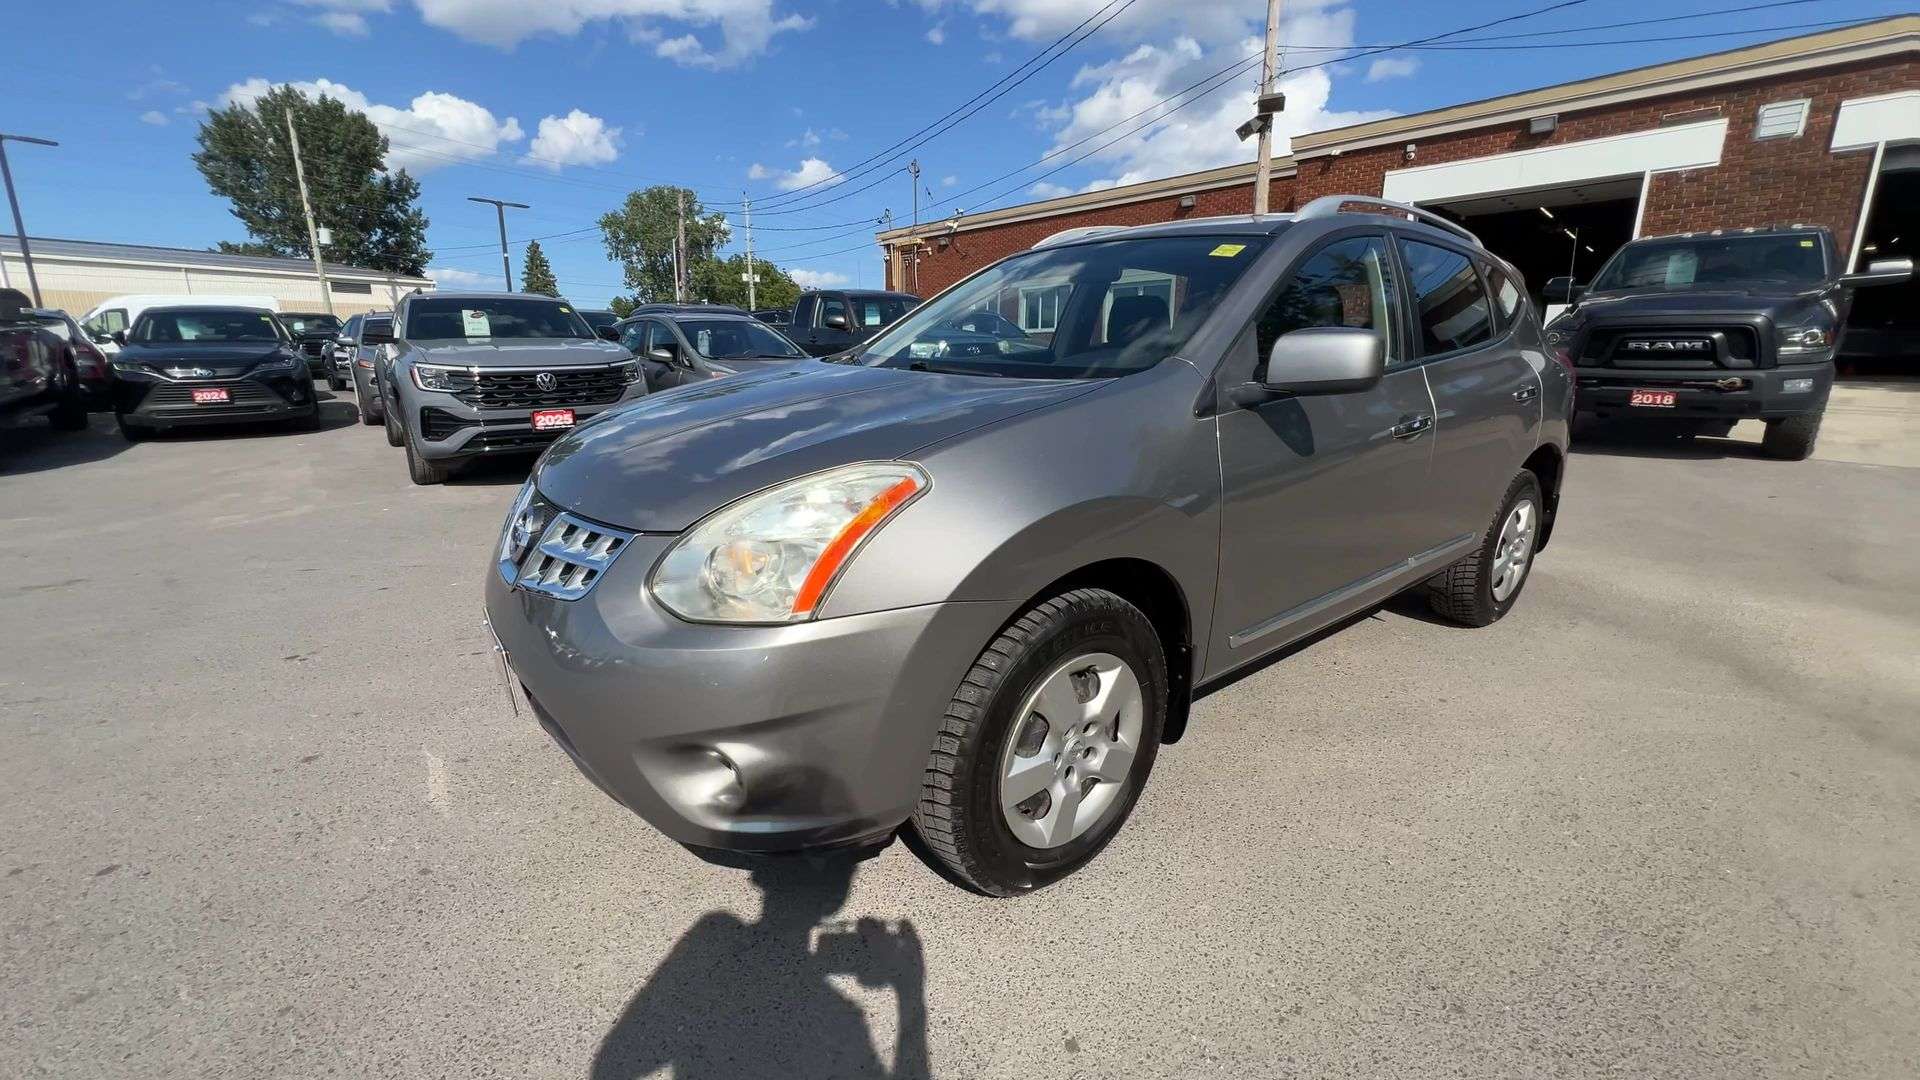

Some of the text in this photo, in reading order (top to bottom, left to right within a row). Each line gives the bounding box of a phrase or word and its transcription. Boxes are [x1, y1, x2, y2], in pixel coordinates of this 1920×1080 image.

[1628, 342, 1704, 351] RAM
[194, 390, 227, 401] 2024
[1631, 393, 1674, 404] 2018
[535, 413, 573, 426] 2025
